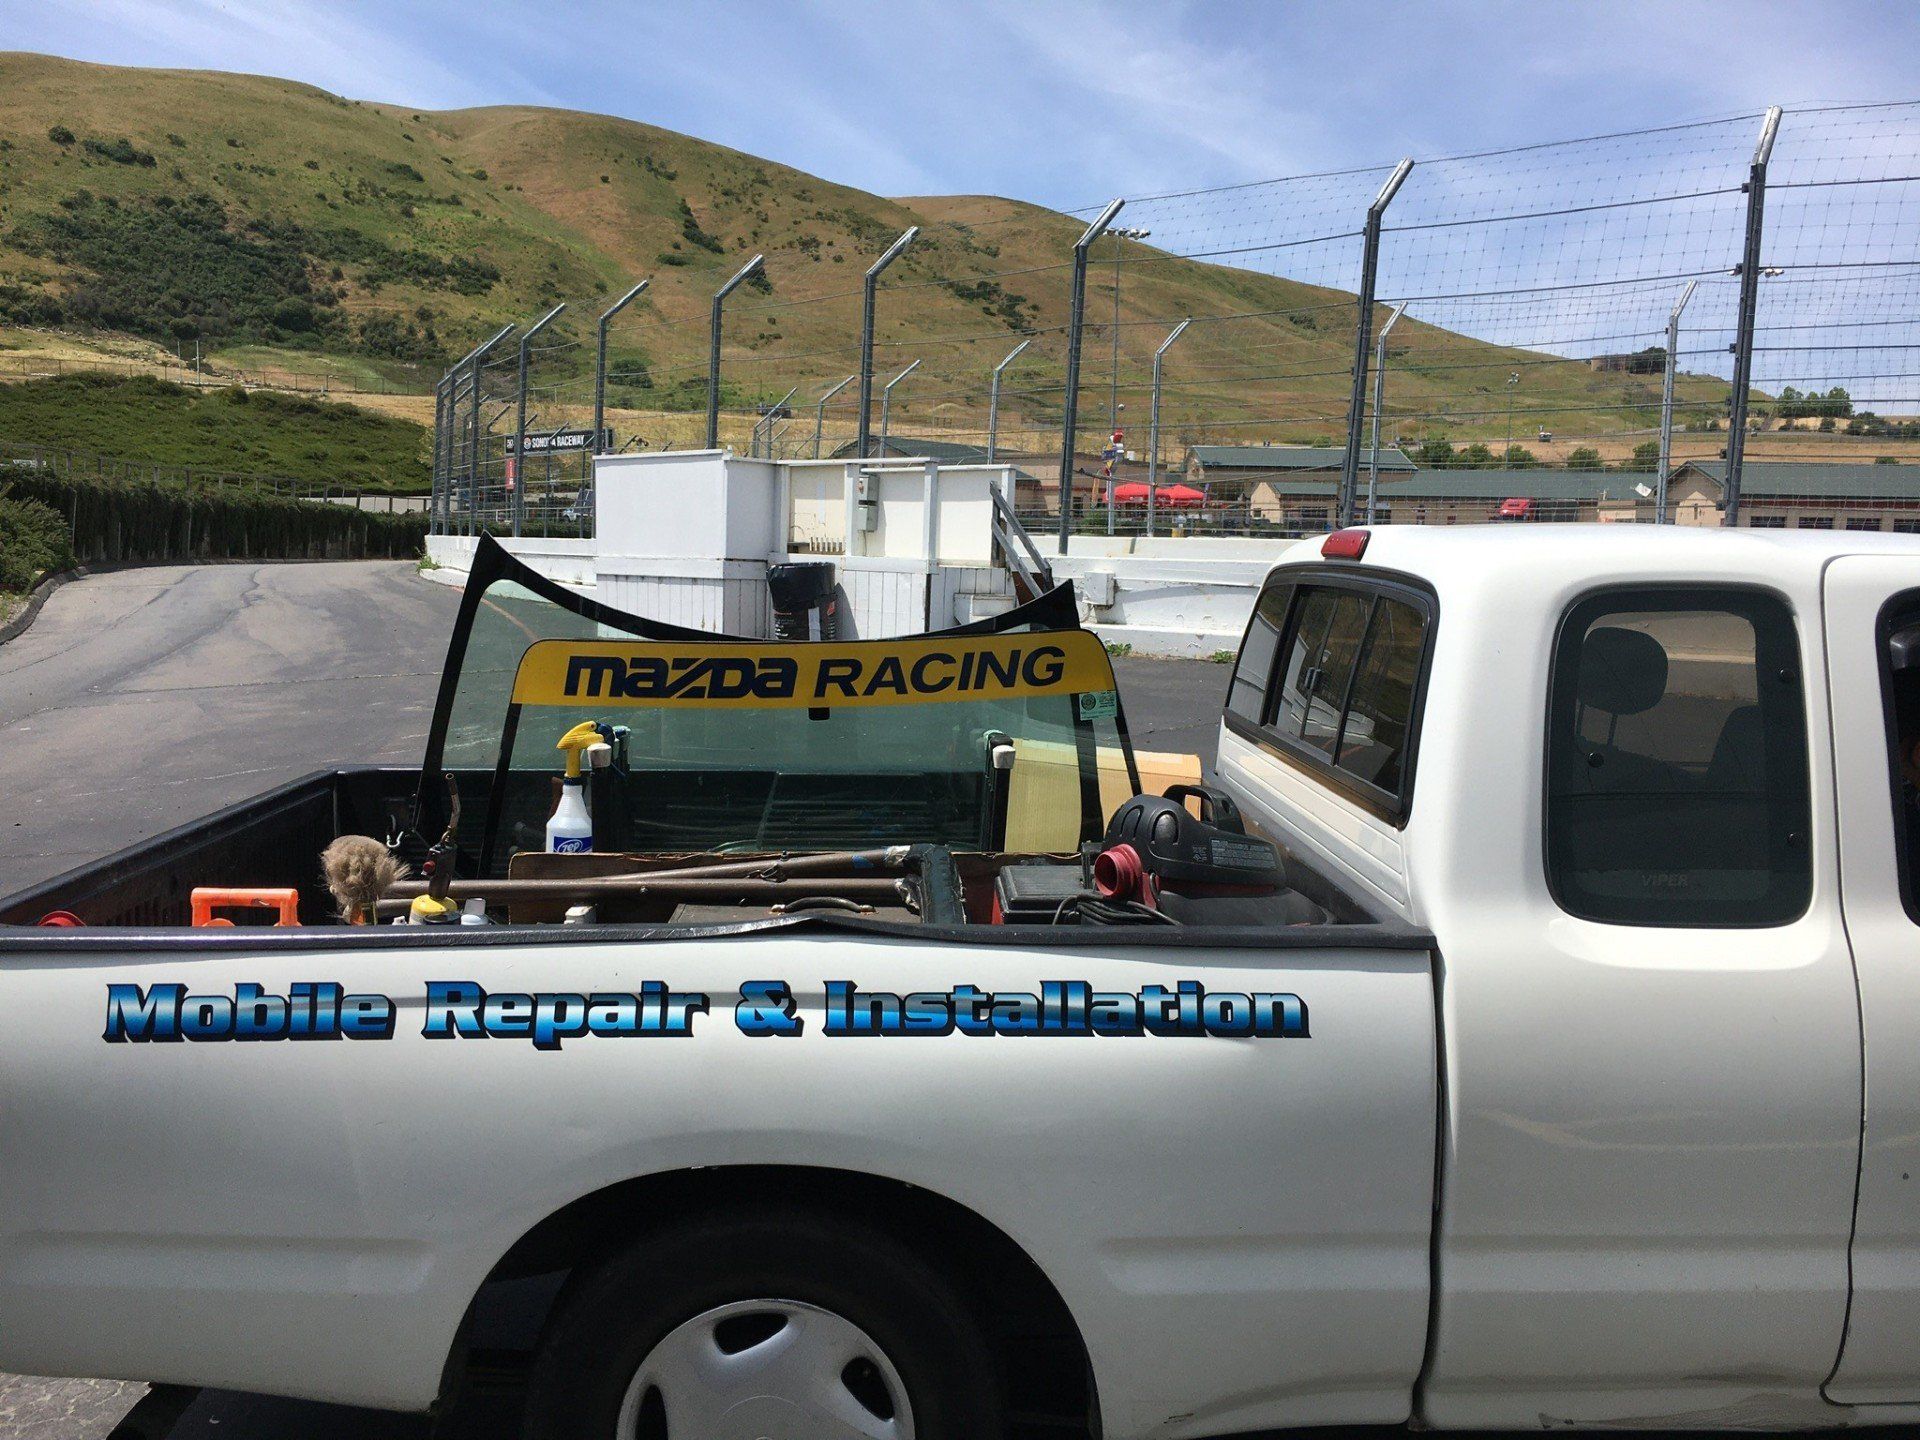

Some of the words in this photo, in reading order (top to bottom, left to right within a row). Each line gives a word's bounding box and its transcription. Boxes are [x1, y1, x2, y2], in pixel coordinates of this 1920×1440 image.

[531, 436, 557, 448] SONOA
[556, 434, 585, 447] RACEWAY
[814, 646, 1066, 698] RACING
[1641, 873, 1689, 888] VIPER
[102, 982, 397, 1043] Mobile
[421, 980, 710, 1051] Repair
[735, 980, 804, 1038] &
[822, 980, 1311, 1038] Installation
